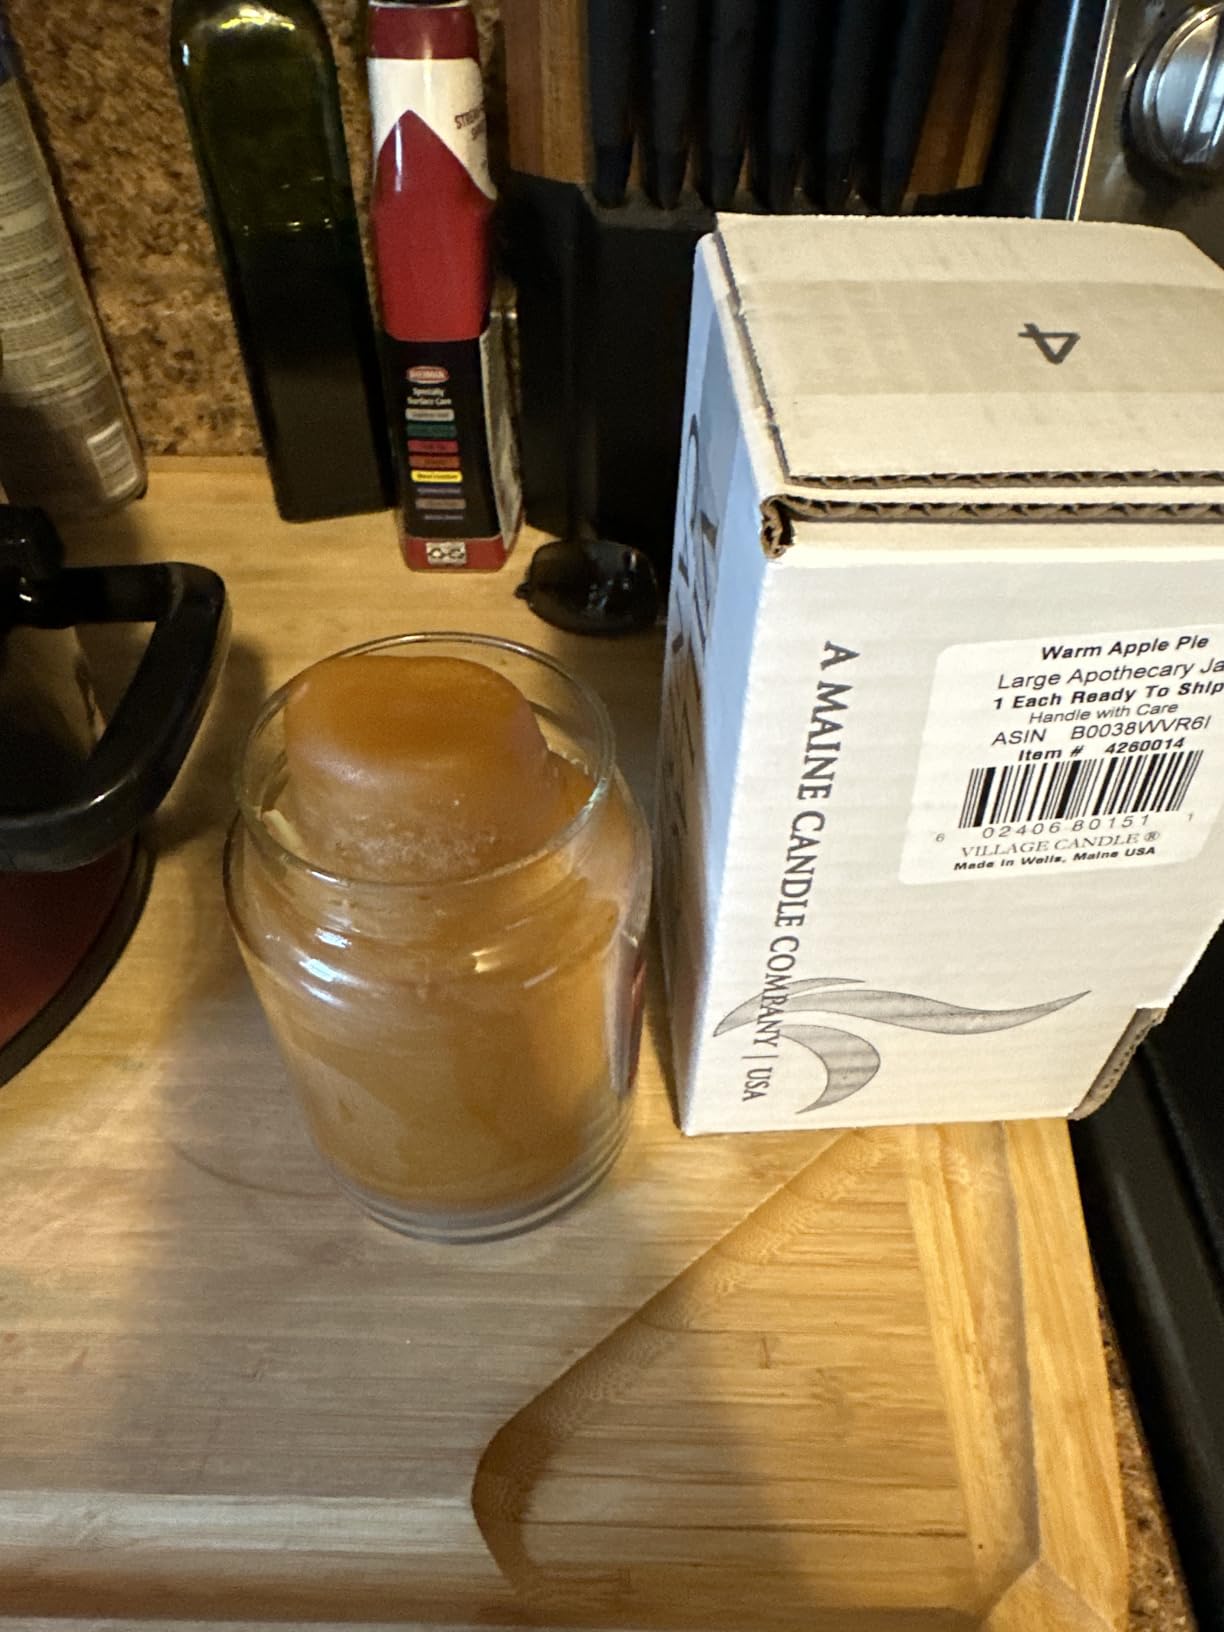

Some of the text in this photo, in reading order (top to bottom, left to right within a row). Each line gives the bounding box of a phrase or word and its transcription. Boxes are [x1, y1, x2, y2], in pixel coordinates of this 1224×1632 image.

[1018, 323, 1080, 364] 4
[820, 640, 860, 671] A
[1042, 635, 1209, 660] Warm Apple Pie
[998, 658, 1224, 691] Large Apothecary Ja
[994, 680, 1224, 710] 1 Each Ready To Ship
[1029, 702, 1179, 724] Handle with Care
[797, 680, 853, 801] MAINE
[992, 728, 1047, 746] ASIN
[1018, 737, 1187, 762] Item # 4260014
[935, 832, 945, 843] 6
[961, 841, 1050, 858] VILLAGE
[1054, 832, 1139, 850] CANDLE
[774, 810, 826, 928] CANDLE
[953, 846, 1156, 871] Made in Wells, Maine USA
[753, 935, 800, 1048] COMPANY
[743, 1066, 773, 1102] USA
